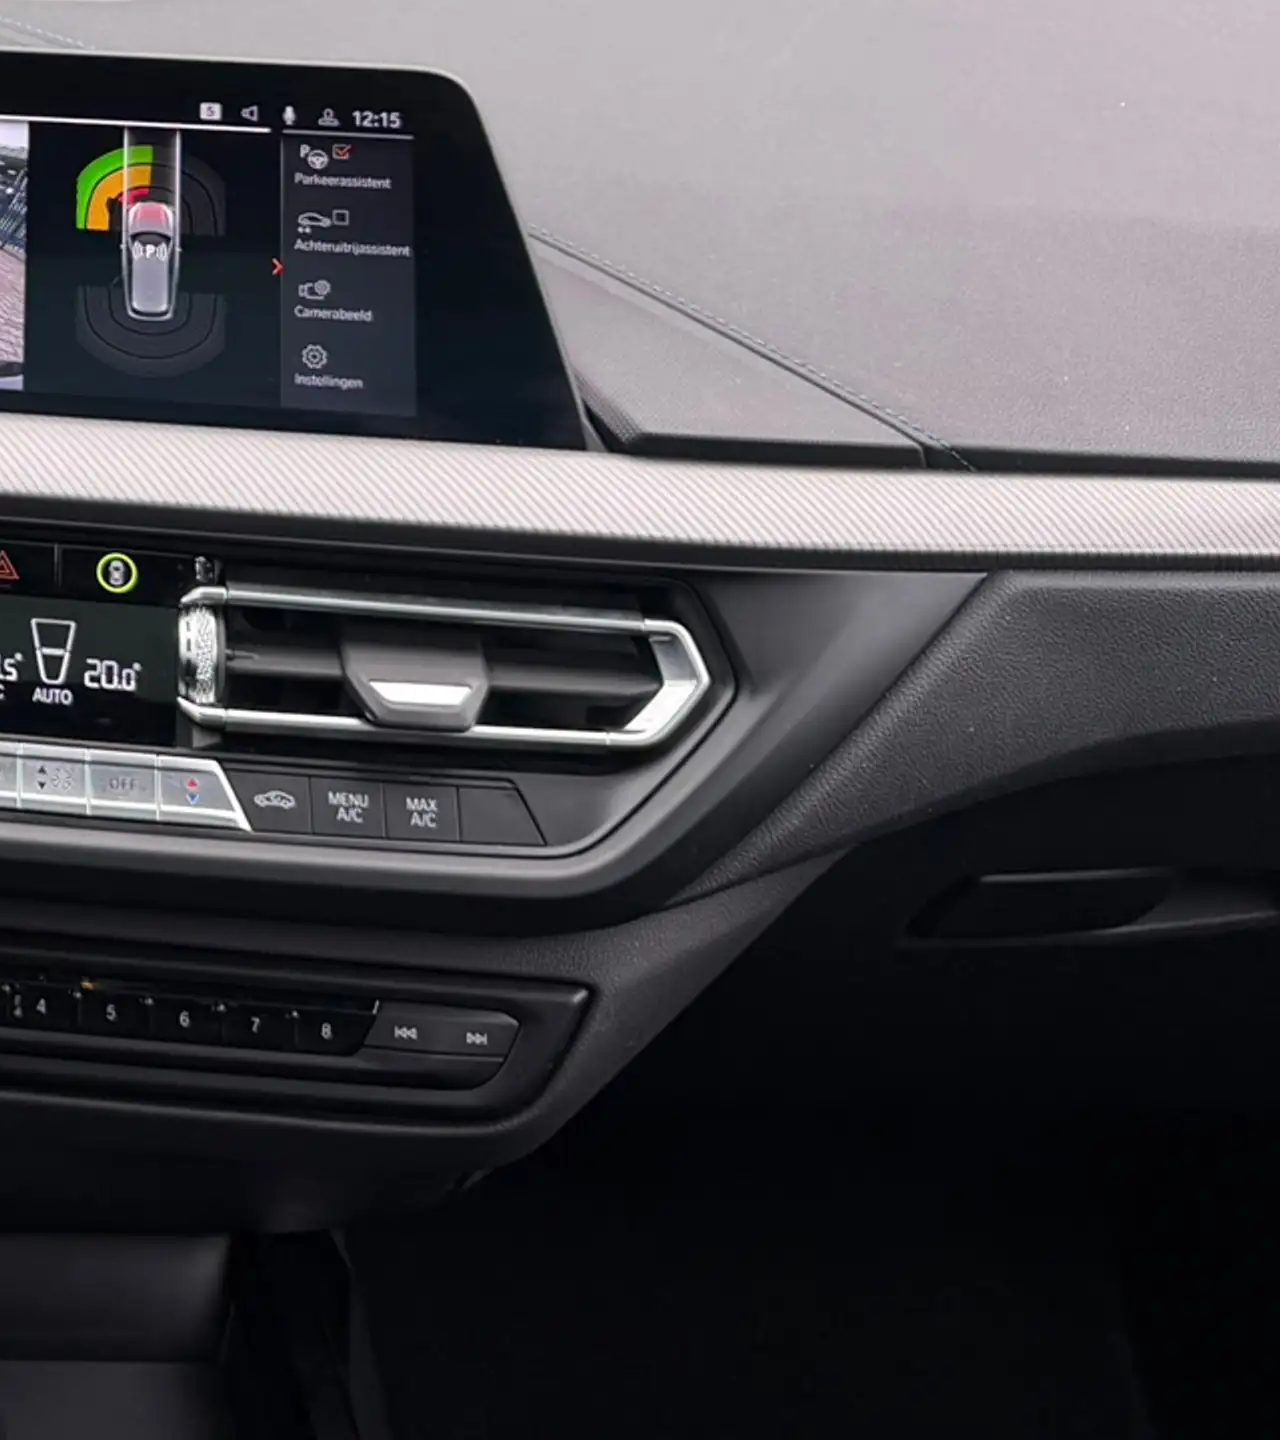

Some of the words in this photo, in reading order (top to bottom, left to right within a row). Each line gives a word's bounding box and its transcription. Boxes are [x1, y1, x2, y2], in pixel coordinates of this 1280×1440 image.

[351, 111, 402, 128] 12:15
[294, 172, 392, 189] Parkeerassistent
[294, 238, 411, 257] Achteruitrijassistent
[294, 304, 373, 322] Camerabeeld
[294, 372, 364, 390] Instellingen
[31, 687, 74, 705] AUTO
[108, 777, 138, 792] OFF
[327, 790, 370, 809] MENU
[405, 796, 438, 813] MAX
[336, 806, 363, 824] A/C
[410, 811, 437, 829] A/C
[36, 998, 46, 1014] 4
[105, 1004, 118, 1022] 5
[179, 1010, 191, 1028] 6
[250, 1016, 261, 1033] 7
[320, 1022, 332, 1039] 8
